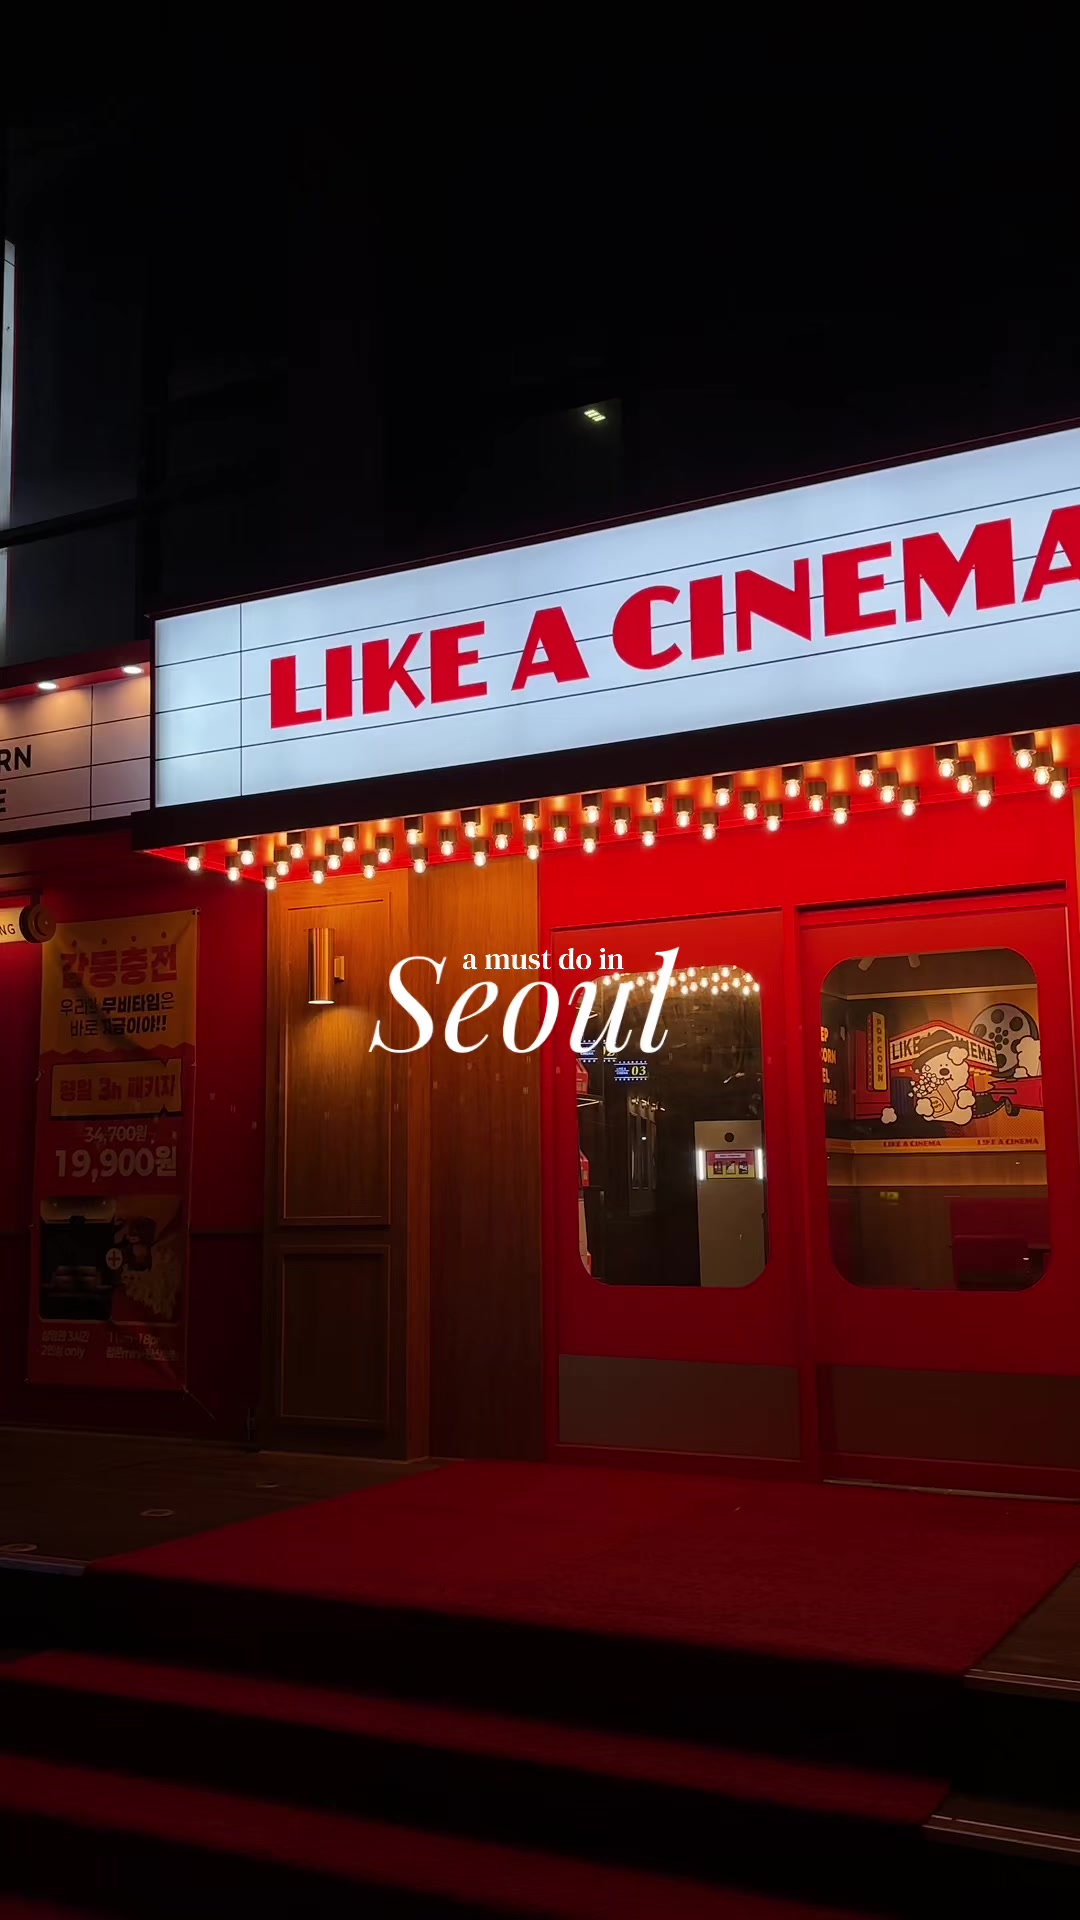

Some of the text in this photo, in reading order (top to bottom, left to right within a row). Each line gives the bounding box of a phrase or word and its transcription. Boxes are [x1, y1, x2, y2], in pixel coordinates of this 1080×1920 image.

[271, 504, 1080, 729] LIKE A CINEMA
[60, 943, 178, 989] 감동충전
[101, 992, 176, 1015] 무비타임은
[70, 1014, 168, 1037] 바로 지금이야!!
[875, 1017, 884, 1083] POPCORN
[631, 1065, 647, 1077] 03
[59, 1078, 93, 1102] 평일
[127, 1074, 176, 1099] 패키지
[55, 1145, 177, 1183] 19,900원
